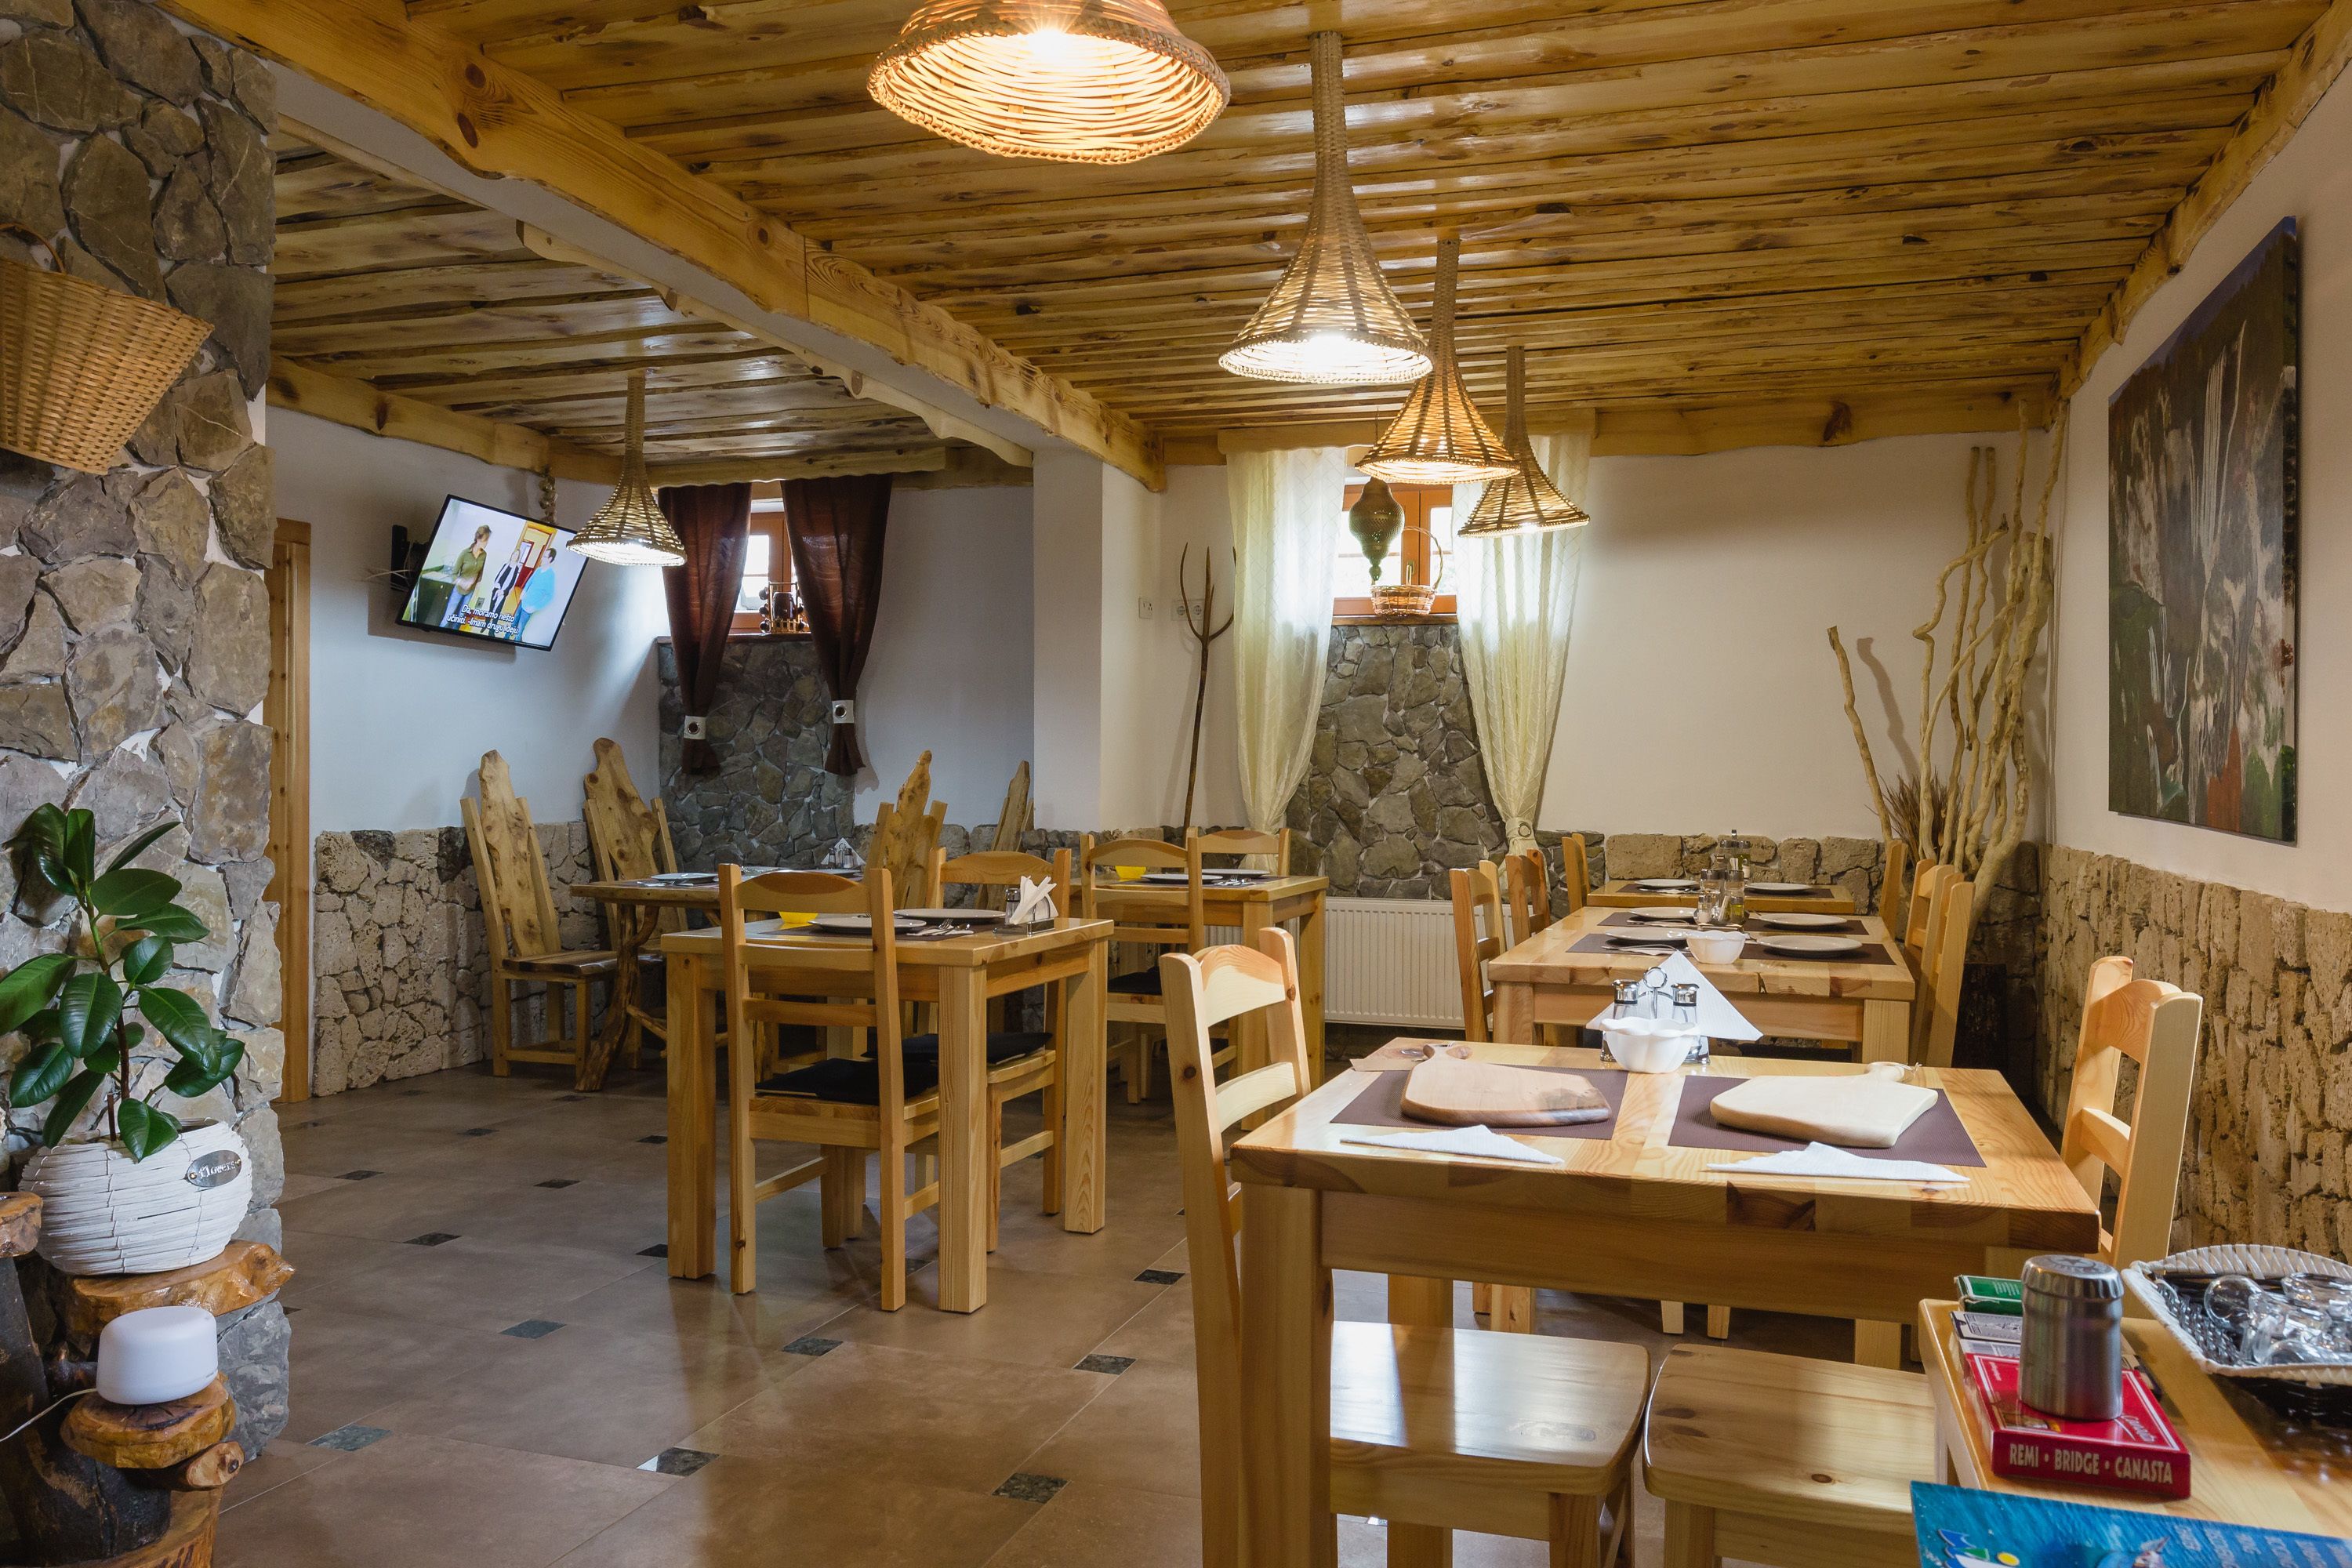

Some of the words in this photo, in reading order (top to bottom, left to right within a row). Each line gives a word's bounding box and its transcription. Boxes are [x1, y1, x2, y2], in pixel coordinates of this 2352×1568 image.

[461, 604, 472, 615] Da,
[473, 608, 499, 619] moramo
[499, 613, 515, 622] nešto
[487, 622, 503, 633] drugu
[504, 625, 519, 636] ideju.
[2009, 1443, 2039, 1468] REMI
[2054, 1450, 2100, 1475] BRIDGE
[2114, 1457, 2173, 1484] CANASTA
